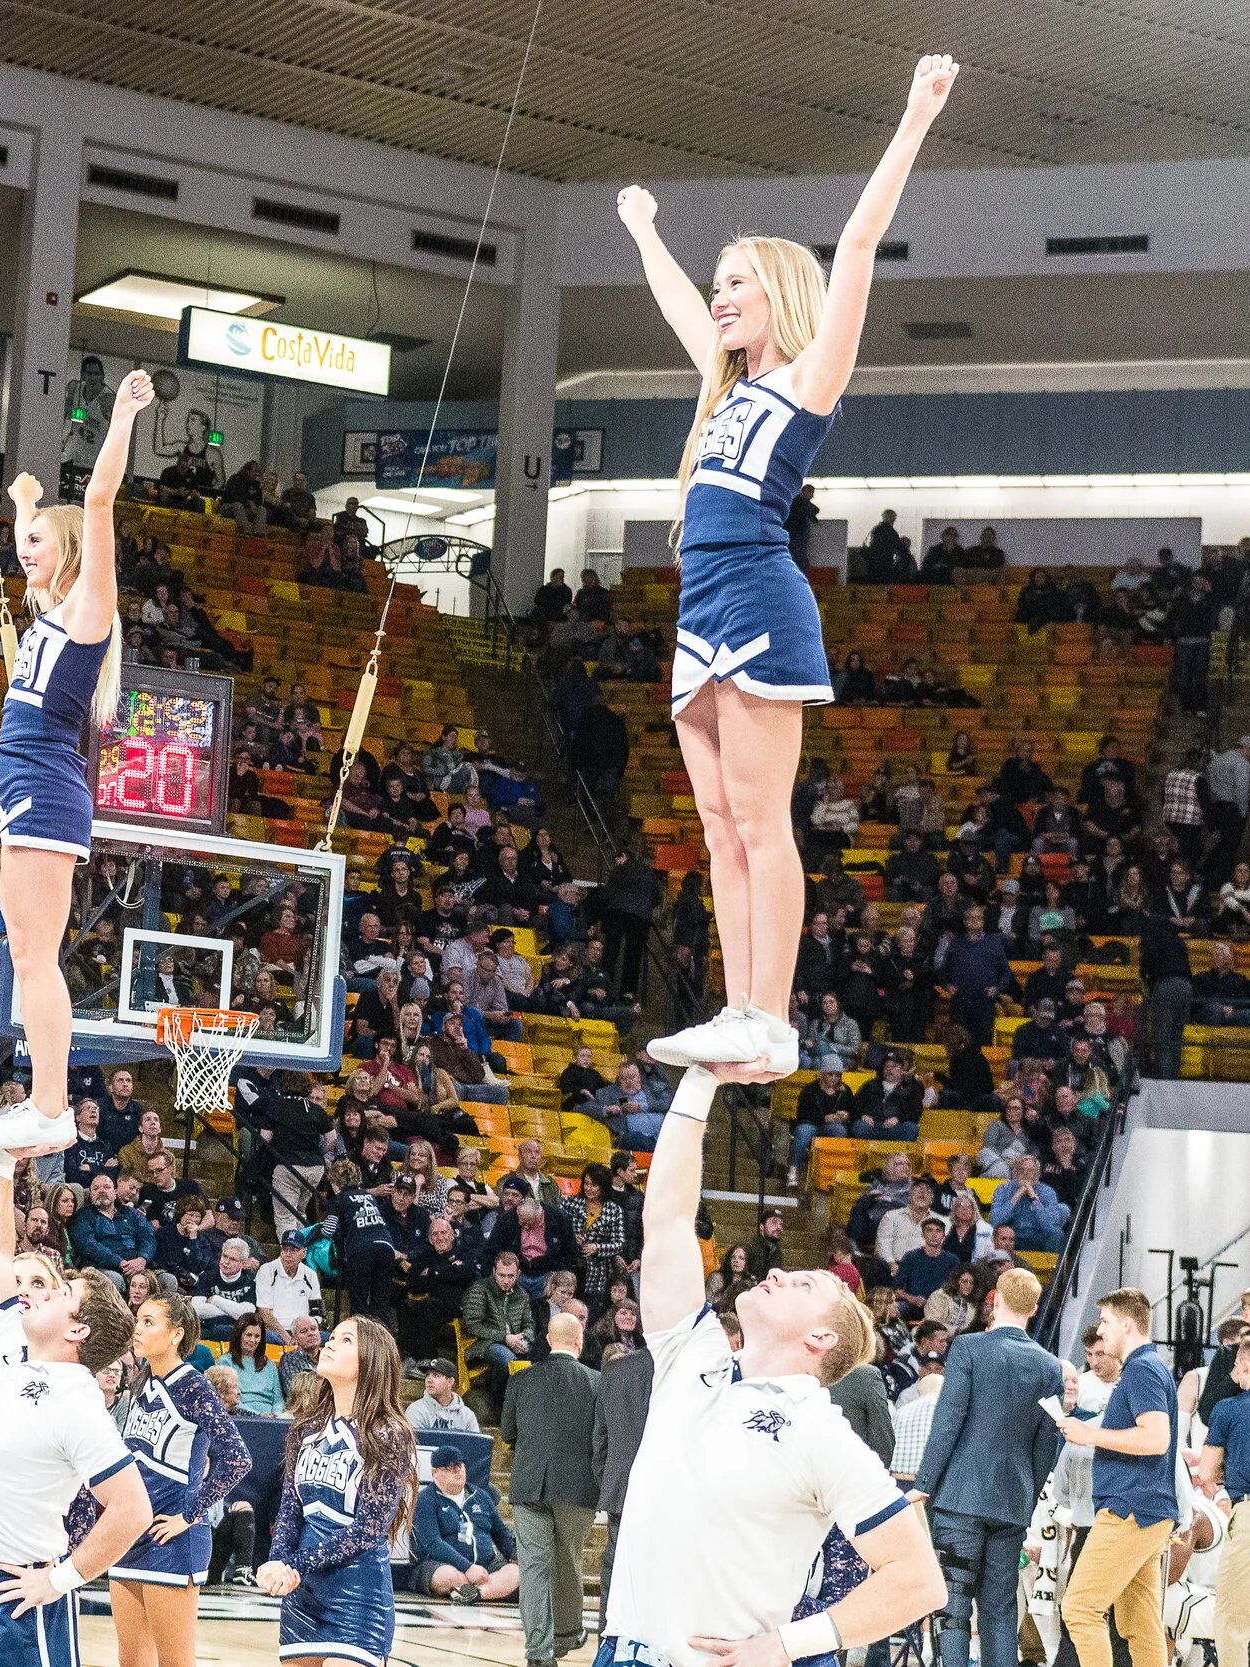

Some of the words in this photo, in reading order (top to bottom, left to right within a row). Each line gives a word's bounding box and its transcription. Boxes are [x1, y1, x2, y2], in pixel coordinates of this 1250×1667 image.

[38, 370, 57, 394] T
[524, 456, 541, 479] U
[117, 737, 194, 814] 20
[297, 1446, 353, 1491] AGGIES
